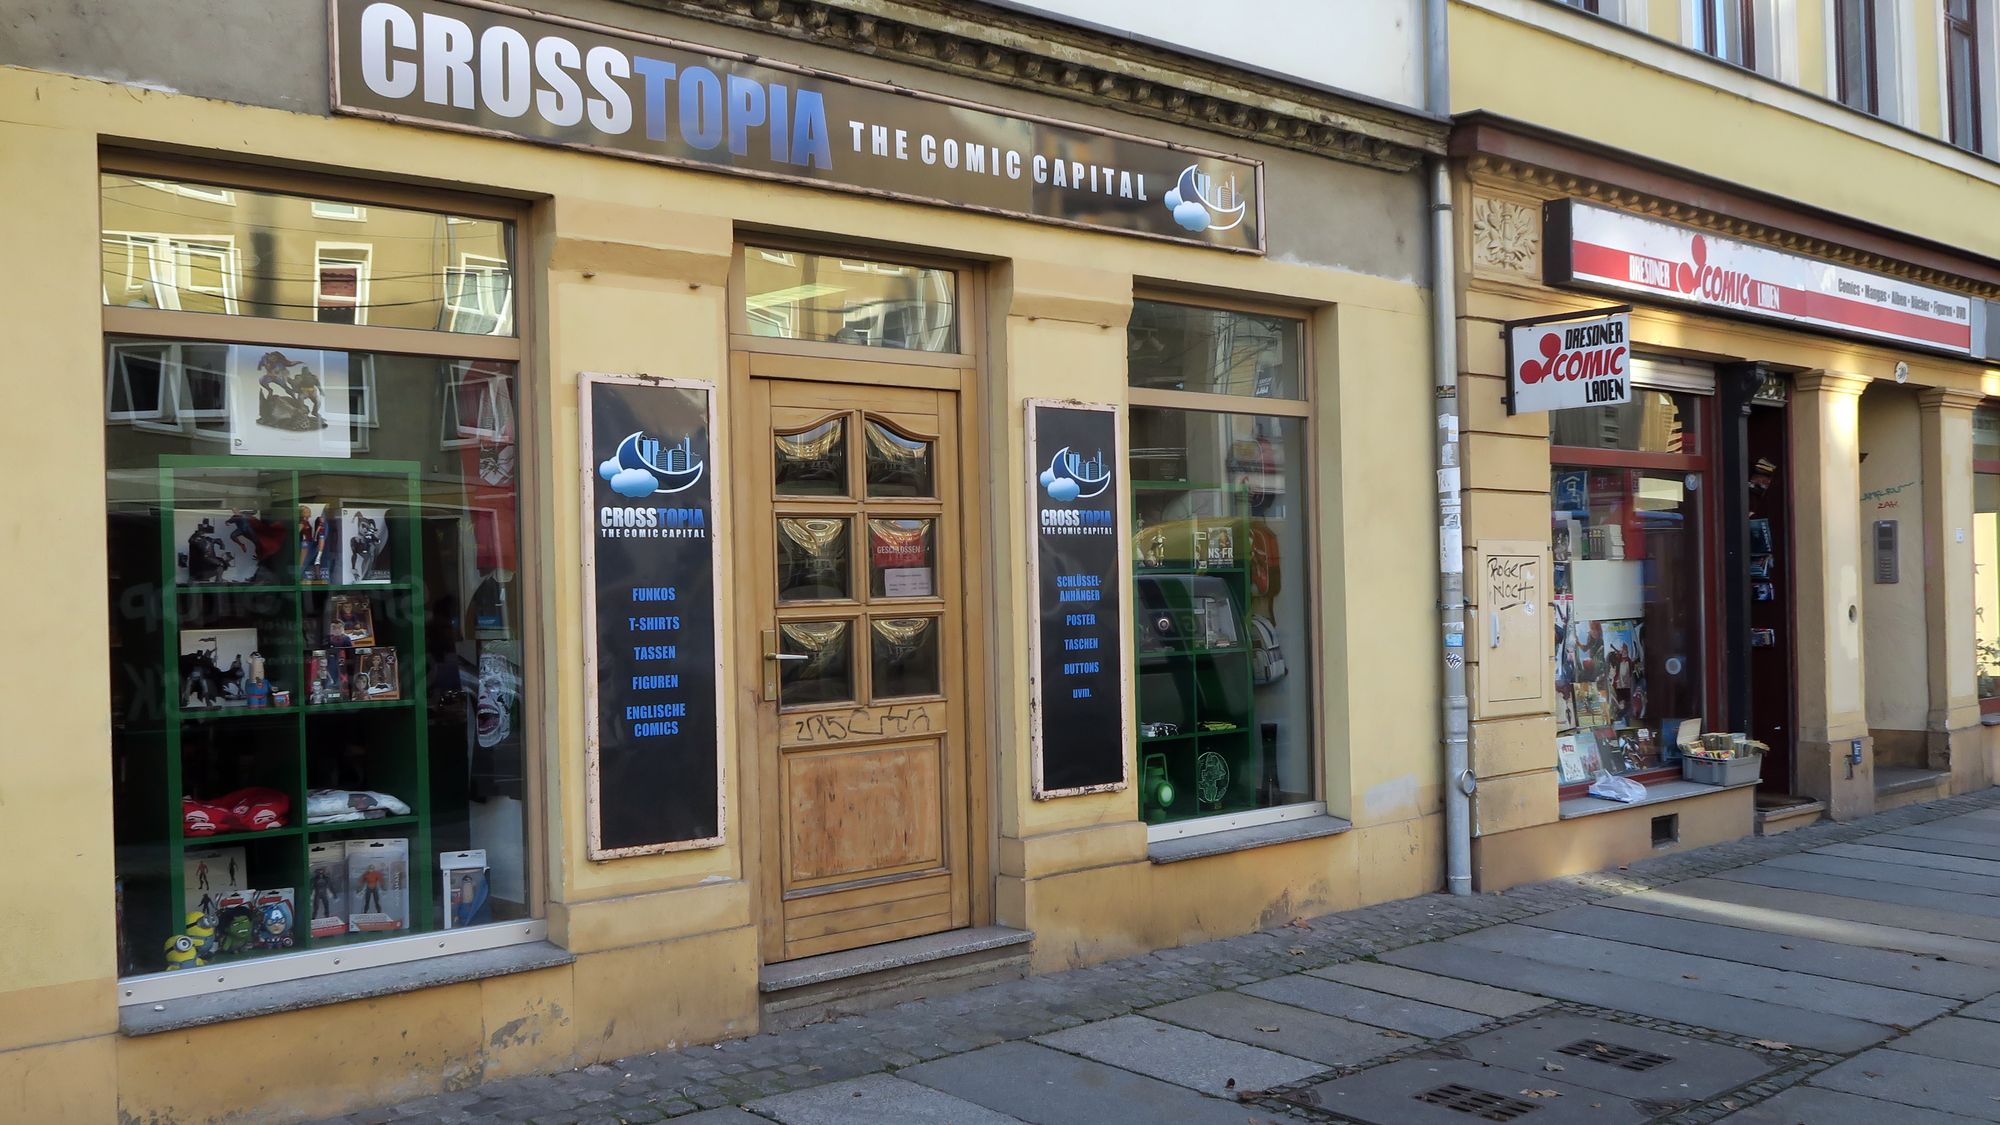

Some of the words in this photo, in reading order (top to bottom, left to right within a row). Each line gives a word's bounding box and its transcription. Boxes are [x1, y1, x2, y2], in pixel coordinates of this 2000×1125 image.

[361, 3, 832, 170] CROSSTOPIA
[849, 121, 908, 161] THE
[920, 134, 1021, 180] COMIC
[1033, 155, 1147, 201] CAPITAL
[1702, 265, 1751, 306] COMIC
[1565, 321, 1623, 350] DRESDNER
[1553, 346, 1626, 382] COMIC
[1585, 378, 1624, 403] LADEN
[601, 507, 705, 529] CROSSTOPIA
[1041, 509, 1112, 527] CROSSTOPIA
[602, 529, 621, 538] THE
[624, 529, 659, 538] COMIC
[662, 529, 705, 538] CAPITAL
[1042, 527, 1056, 535] THE
[1057, 527, 1081, 535] COMIC
[1083, 527, 1112, 535] CAPITAL
[1057, 574, 1102, 587] SCHLÜSSEL-
[632, 587, 676, 602] FUNKOS
[1059, 588, 1100, 602] ANHÄNGER
[628, 616, 680, 631] T-SHIRTS
[1066, 614, 1096, 626] POSTER
[1064, 638, 1099, 650] TASCHEN
[634, 646, 676, 660] TASSEN
[1064, 662, 1099, 675] BUTTONS
[632, 675, 679, 690] FIGUREN
[626, 703, 686, 720] ENGLISCHE
[634, 721, 679, 737] COMICS
